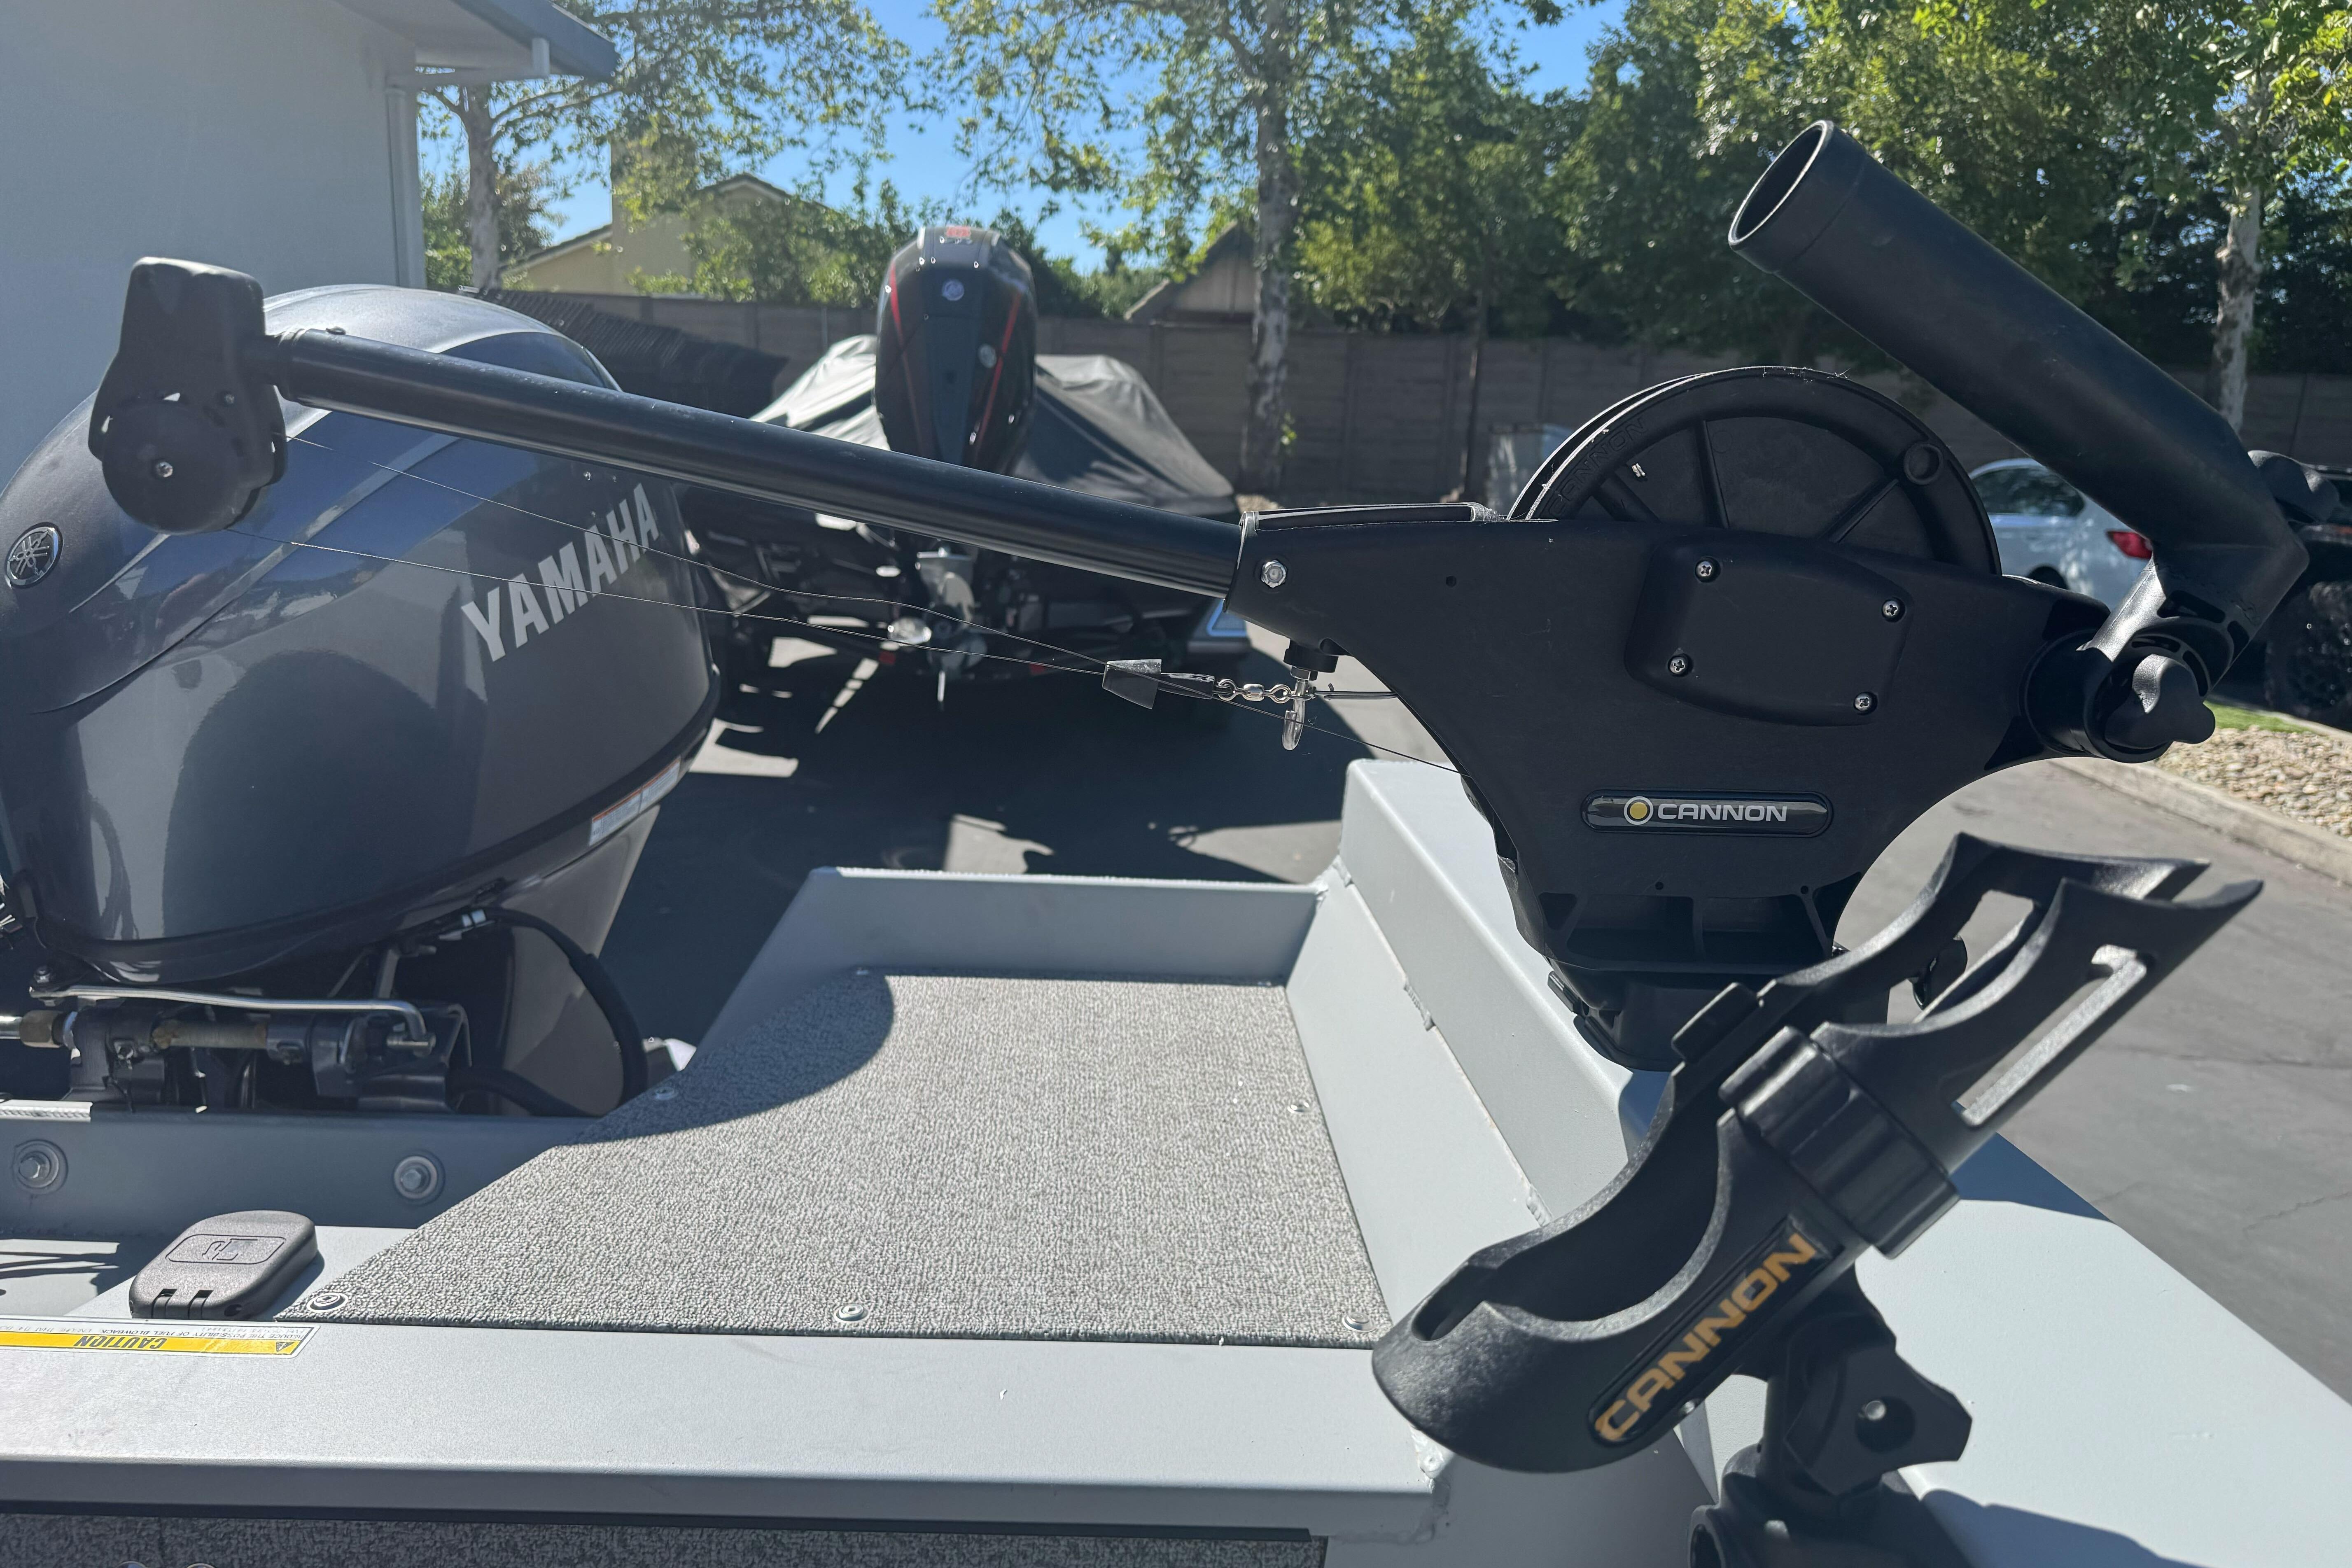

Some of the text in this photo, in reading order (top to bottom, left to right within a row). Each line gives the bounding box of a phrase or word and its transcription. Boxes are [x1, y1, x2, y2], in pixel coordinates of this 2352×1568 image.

[1548, 415, 1645, 517] CANNON
[461, 483, 659, 662] YAMAHA
[1657, 803, 1787, 821] CANNON
[73, 1335, 167, 1349] CAUTION
[1595, 1233, 1817, 1441] CANNON
